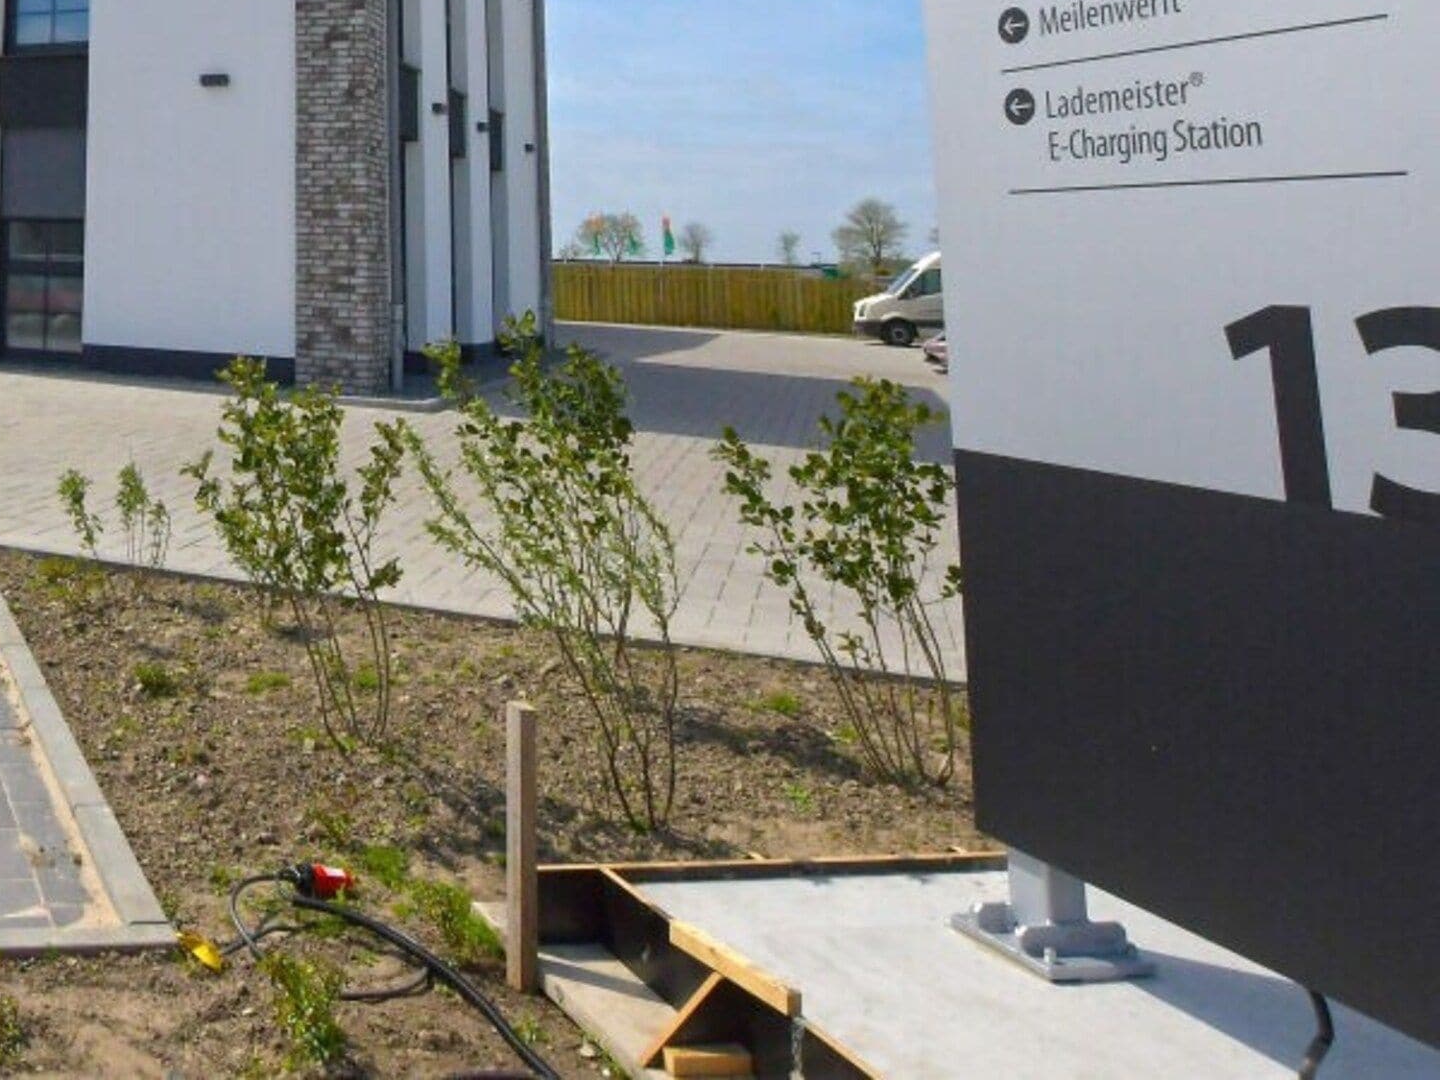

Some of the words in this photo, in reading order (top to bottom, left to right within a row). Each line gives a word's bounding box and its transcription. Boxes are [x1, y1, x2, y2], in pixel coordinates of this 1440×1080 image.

[1048, 127, 1168, 164] E-Charging
[1172, 118, 1263, 153] Station
[1223, 303, 1440, 520] 13
